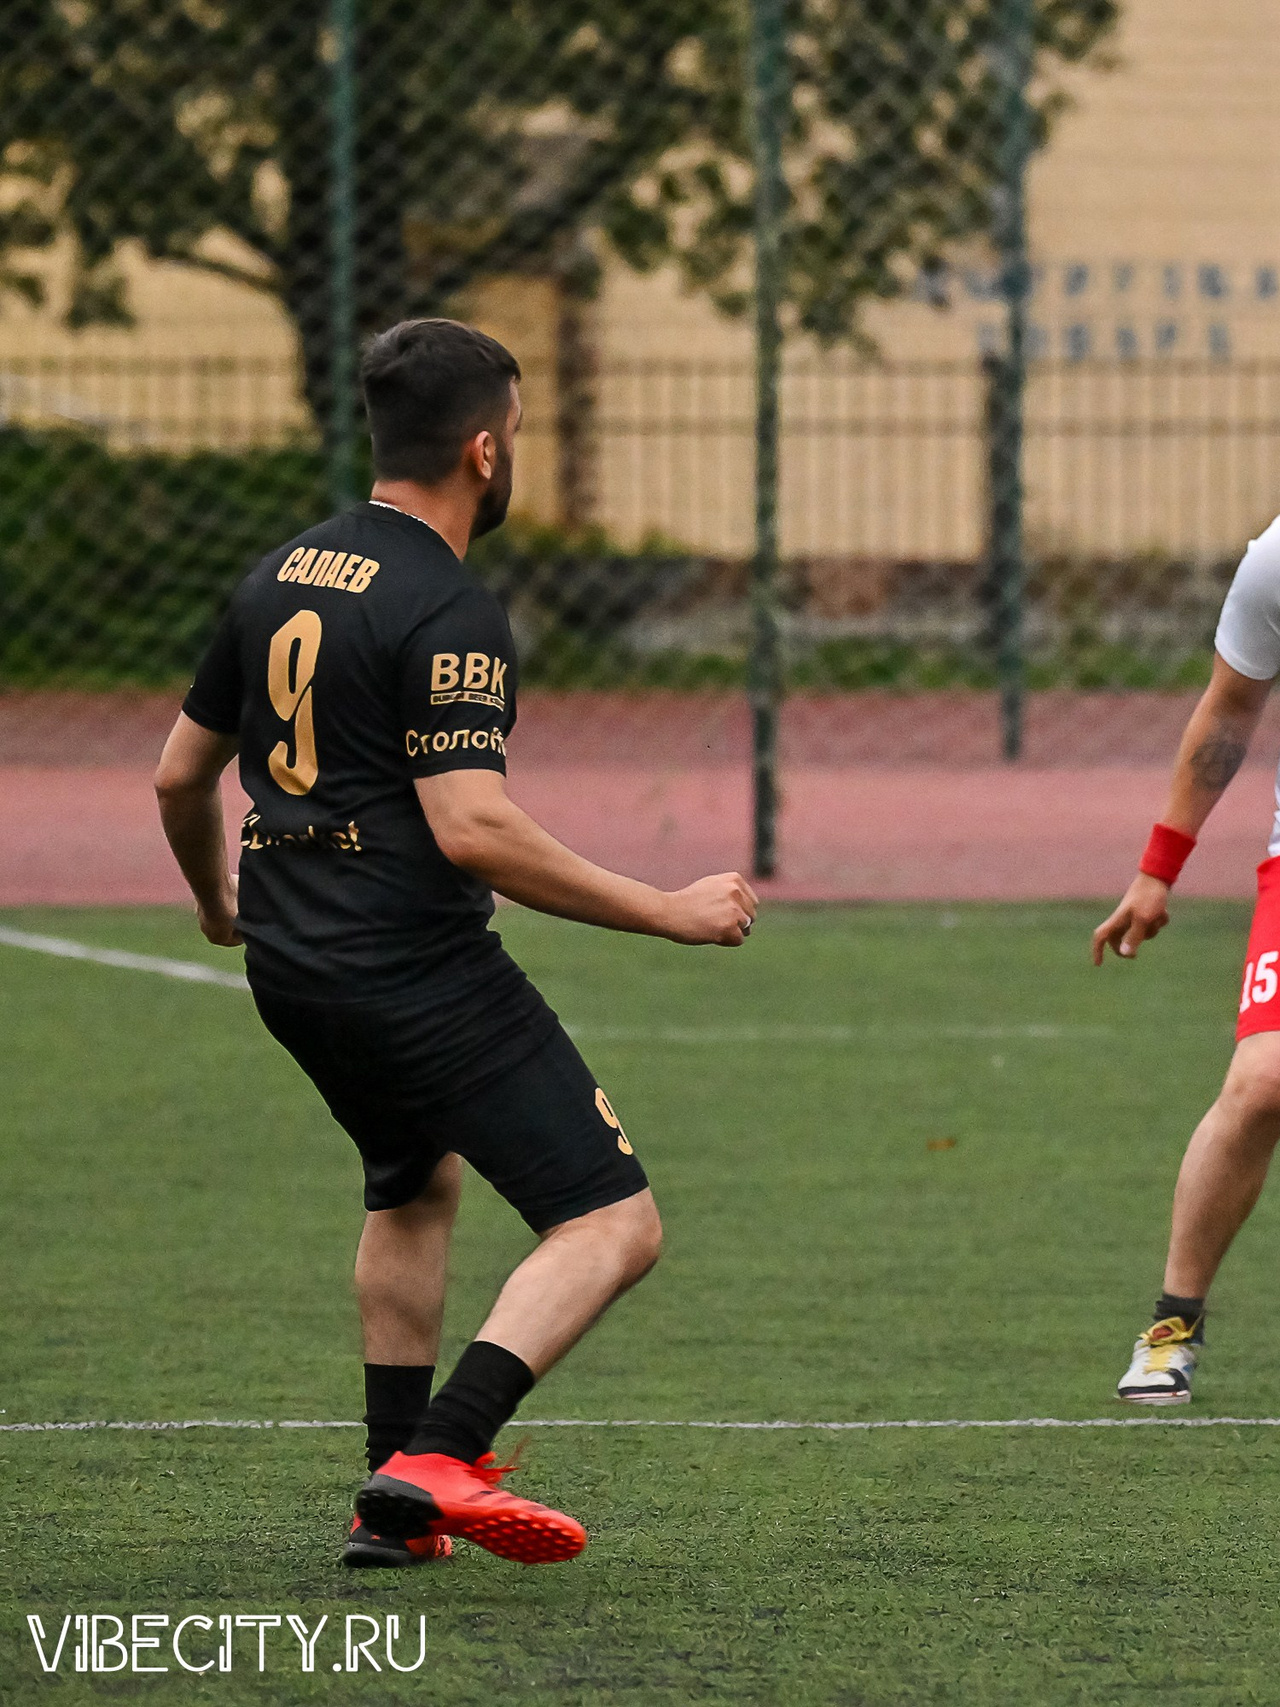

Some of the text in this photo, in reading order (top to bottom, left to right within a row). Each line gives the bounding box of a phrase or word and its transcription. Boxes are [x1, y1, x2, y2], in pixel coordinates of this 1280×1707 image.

[276, 546, 381, 594] САЛАЕВ
[267, 609, 323, 796] 9
[431, 652, 508, 699] BBK
[1239, 950, 1280, 1014] 15
[594, 1087, 634, 1155] 9
